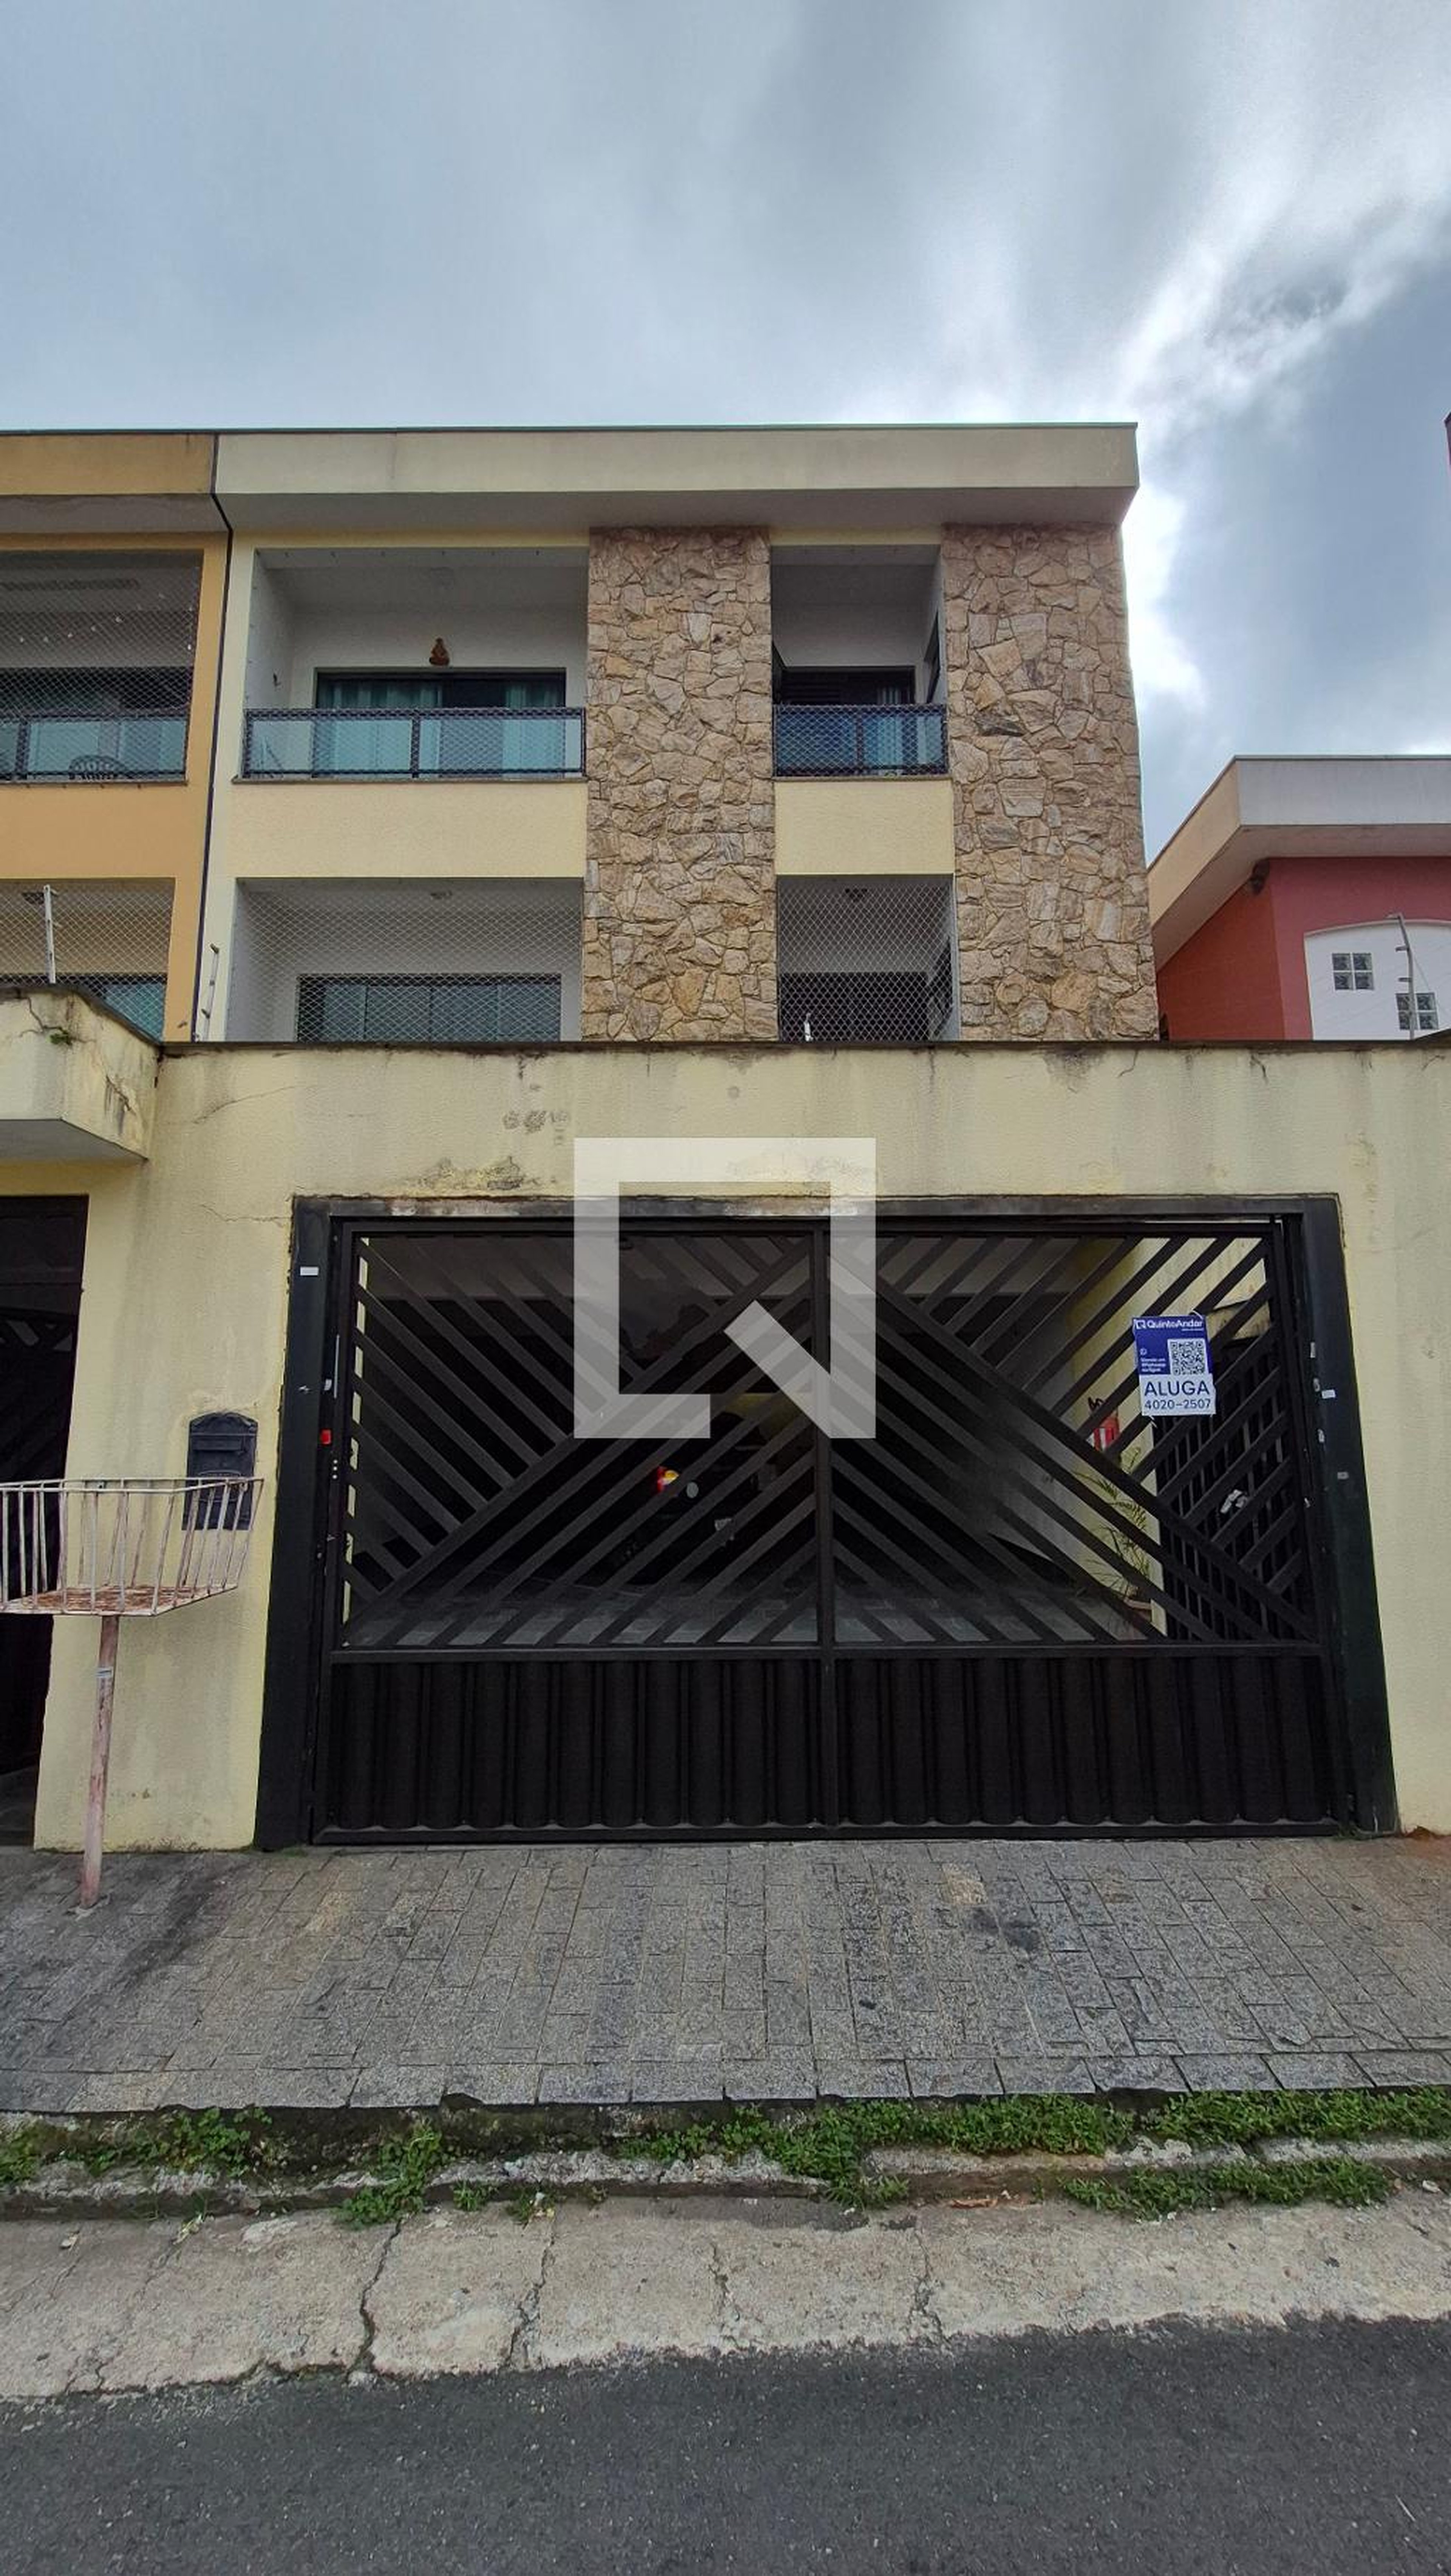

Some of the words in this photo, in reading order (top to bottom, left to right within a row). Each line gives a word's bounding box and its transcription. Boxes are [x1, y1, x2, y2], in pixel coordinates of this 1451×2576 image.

[1147, 1319, 1202, 1328] QuintoAndar
[1145, 1380, 1210, 1396] ALUGA
[1145, 1399, 1211, 1409] 4020-2507
